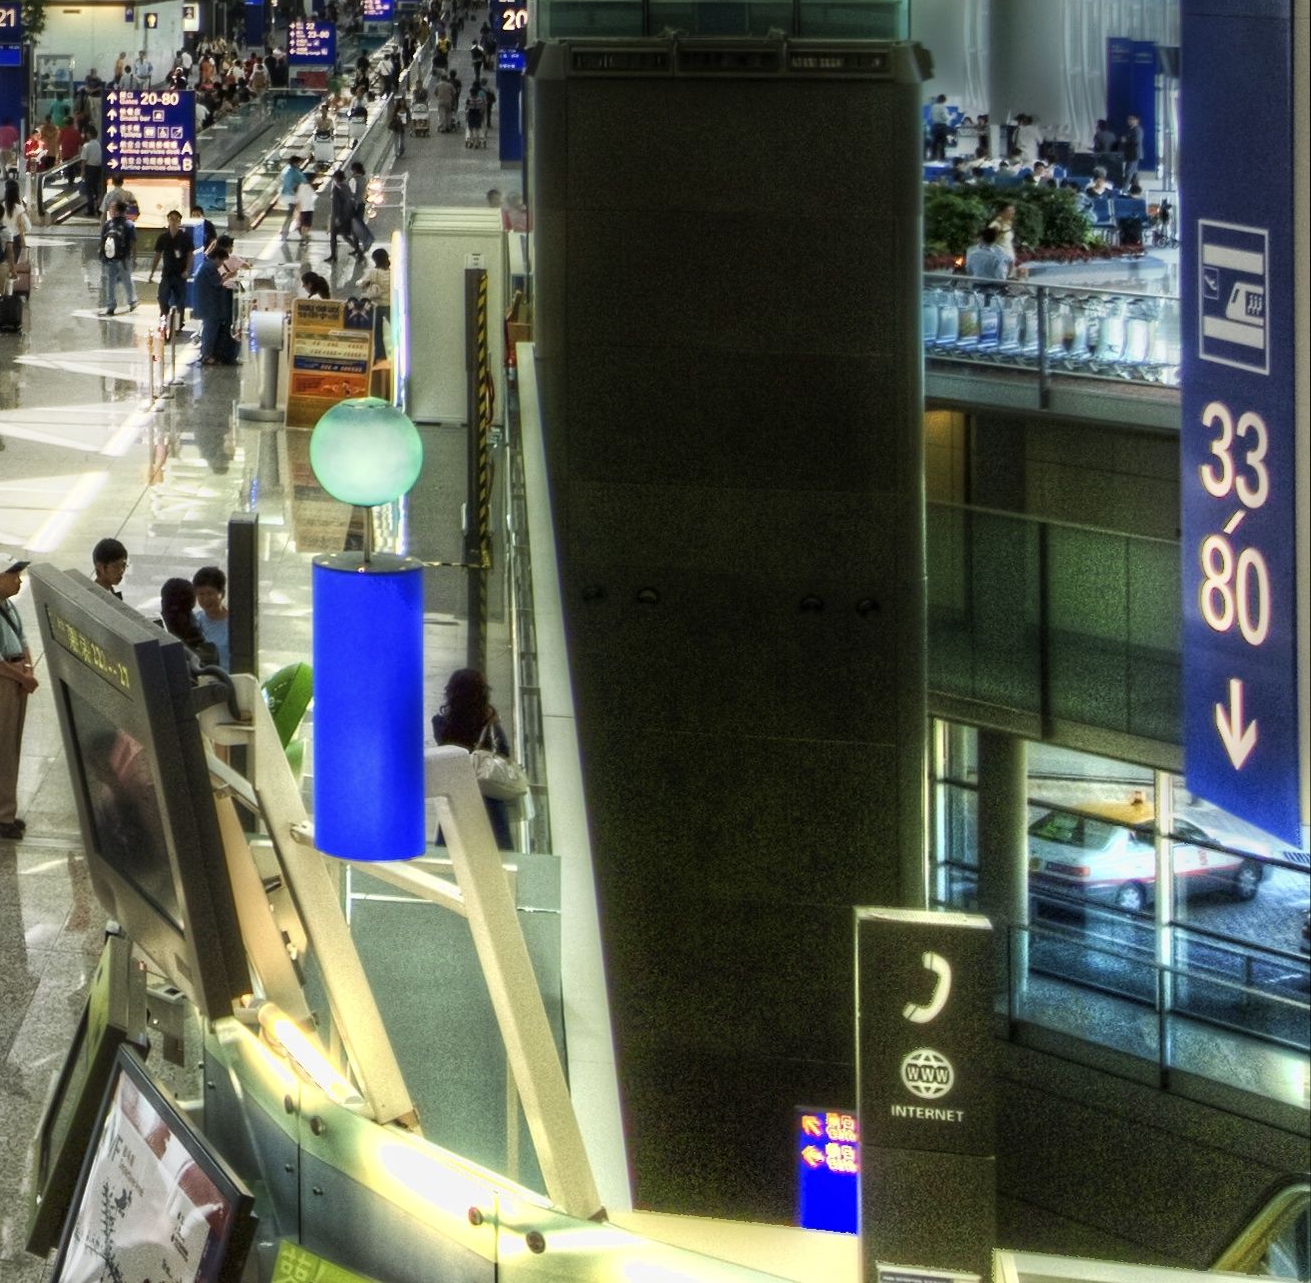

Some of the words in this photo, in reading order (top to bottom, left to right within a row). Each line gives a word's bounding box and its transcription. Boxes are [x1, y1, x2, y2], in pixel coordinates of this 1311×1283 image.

[502, 9, 528, 31] 20
[140, 92, 179, 106] 20-80
[181, 141, 193, 155] A
[182, 158, 193, 172] B
[1201, 401, 1269, 509] 33
[1201, 534, 1270, 646] 80
[906, 1065, 949, 1084] WWW
[891, 1104, 964, 1123] INTERNET
